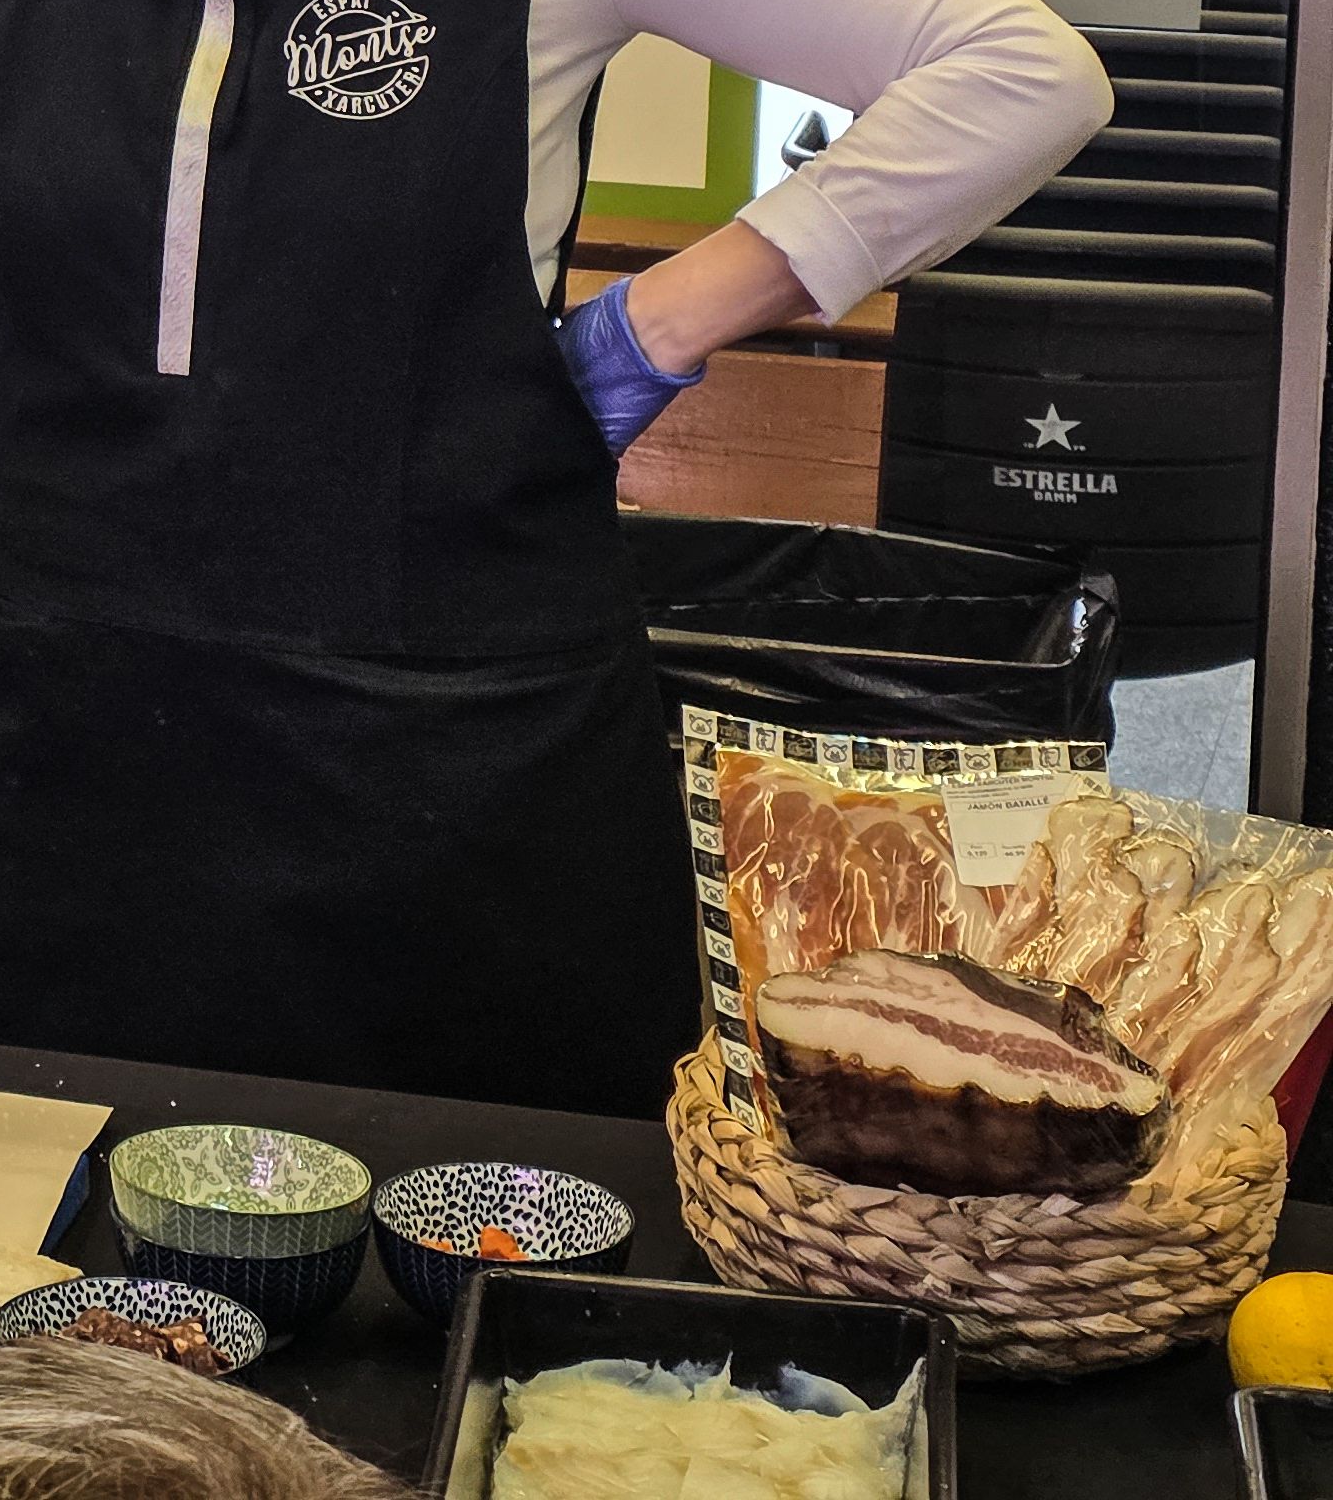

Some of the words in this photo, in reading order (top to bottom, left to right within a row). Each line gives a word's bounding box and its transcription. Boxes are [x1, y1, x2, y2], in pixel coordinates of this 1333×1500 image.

[284, 15, 436, 87] Montse
[321, 70, 422, 114] XARCUTER
[993, 465, 1119, 494] ESTRELLA
[1034, 490, 1078, 504] DAMM
